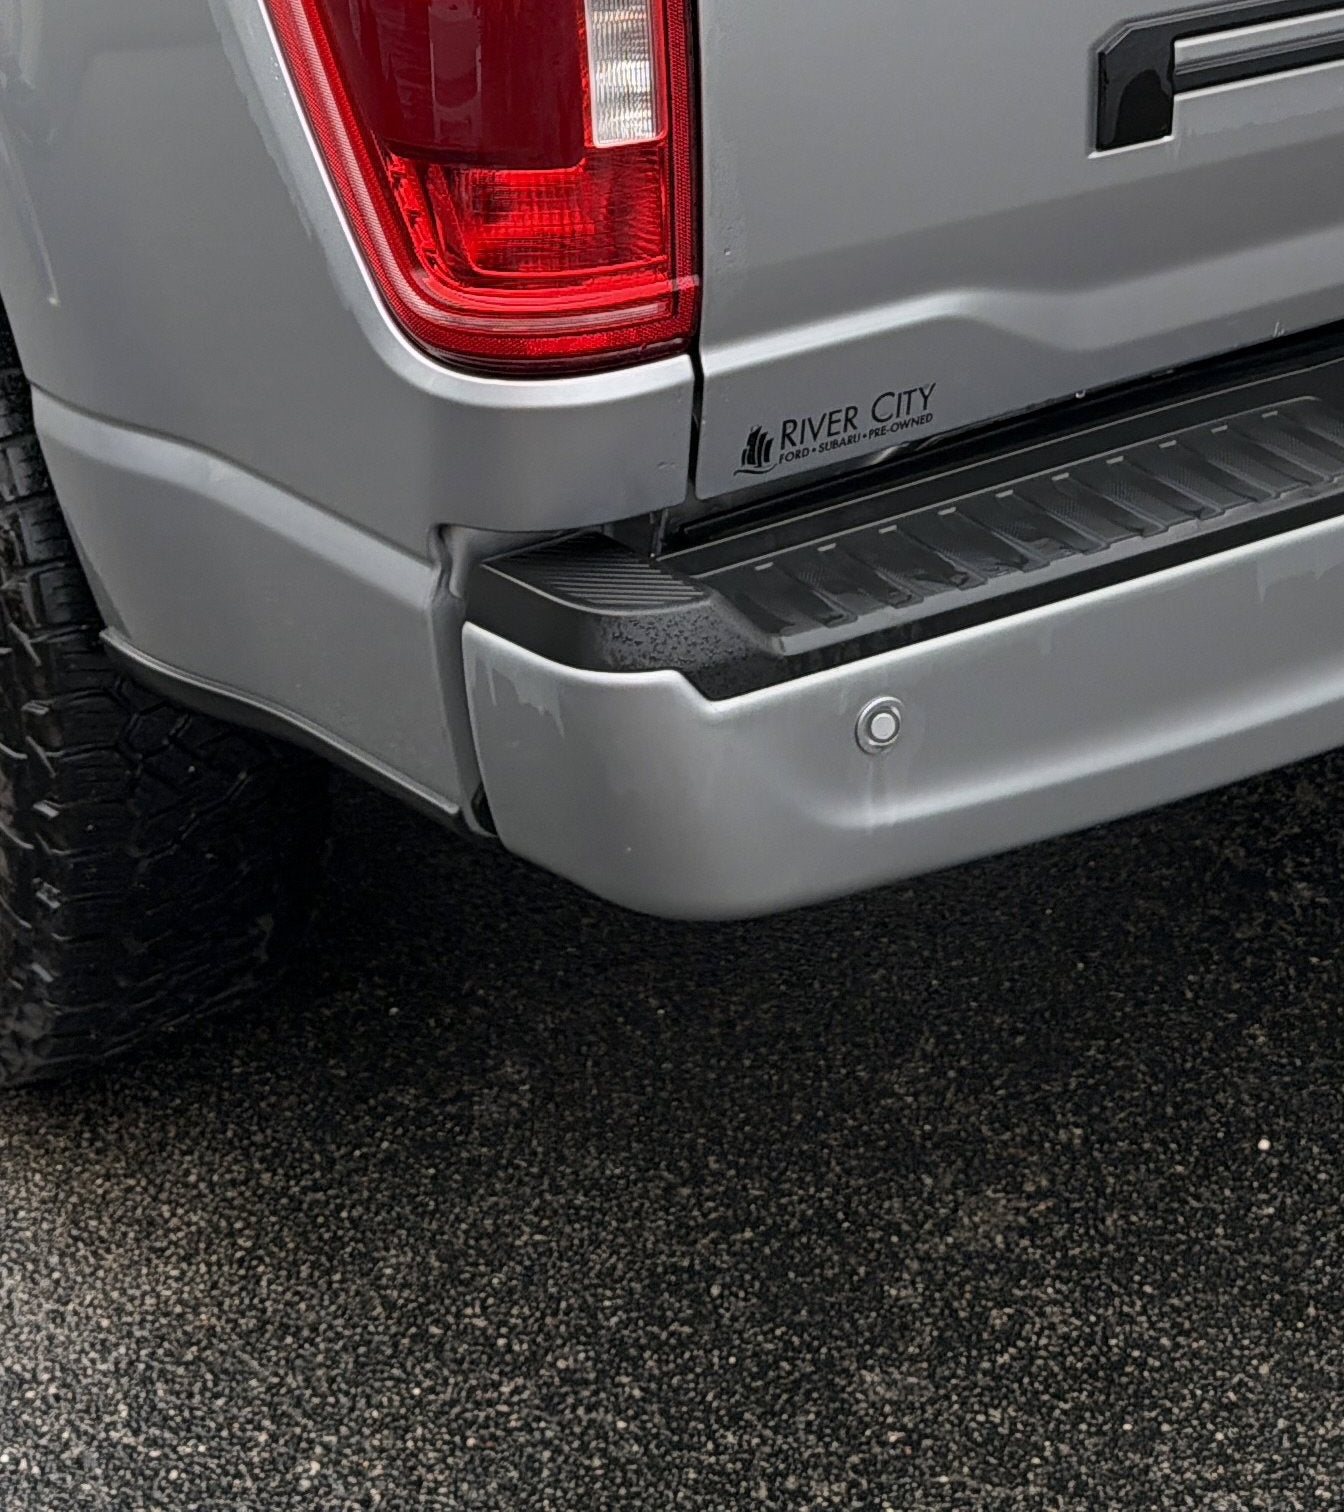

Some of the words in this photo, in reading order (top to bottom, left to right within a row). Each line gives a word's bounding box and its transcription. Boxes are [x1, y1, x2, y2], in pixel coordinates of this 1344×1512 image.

[779, 447, 810, 464] FORD
[818, 434, 861, 453] SUBARU
[868, 413, 934, 439] PRE-OWNED
[780, 405, 859, 451] RIVER
[871, 382, 937, 423] CITY
